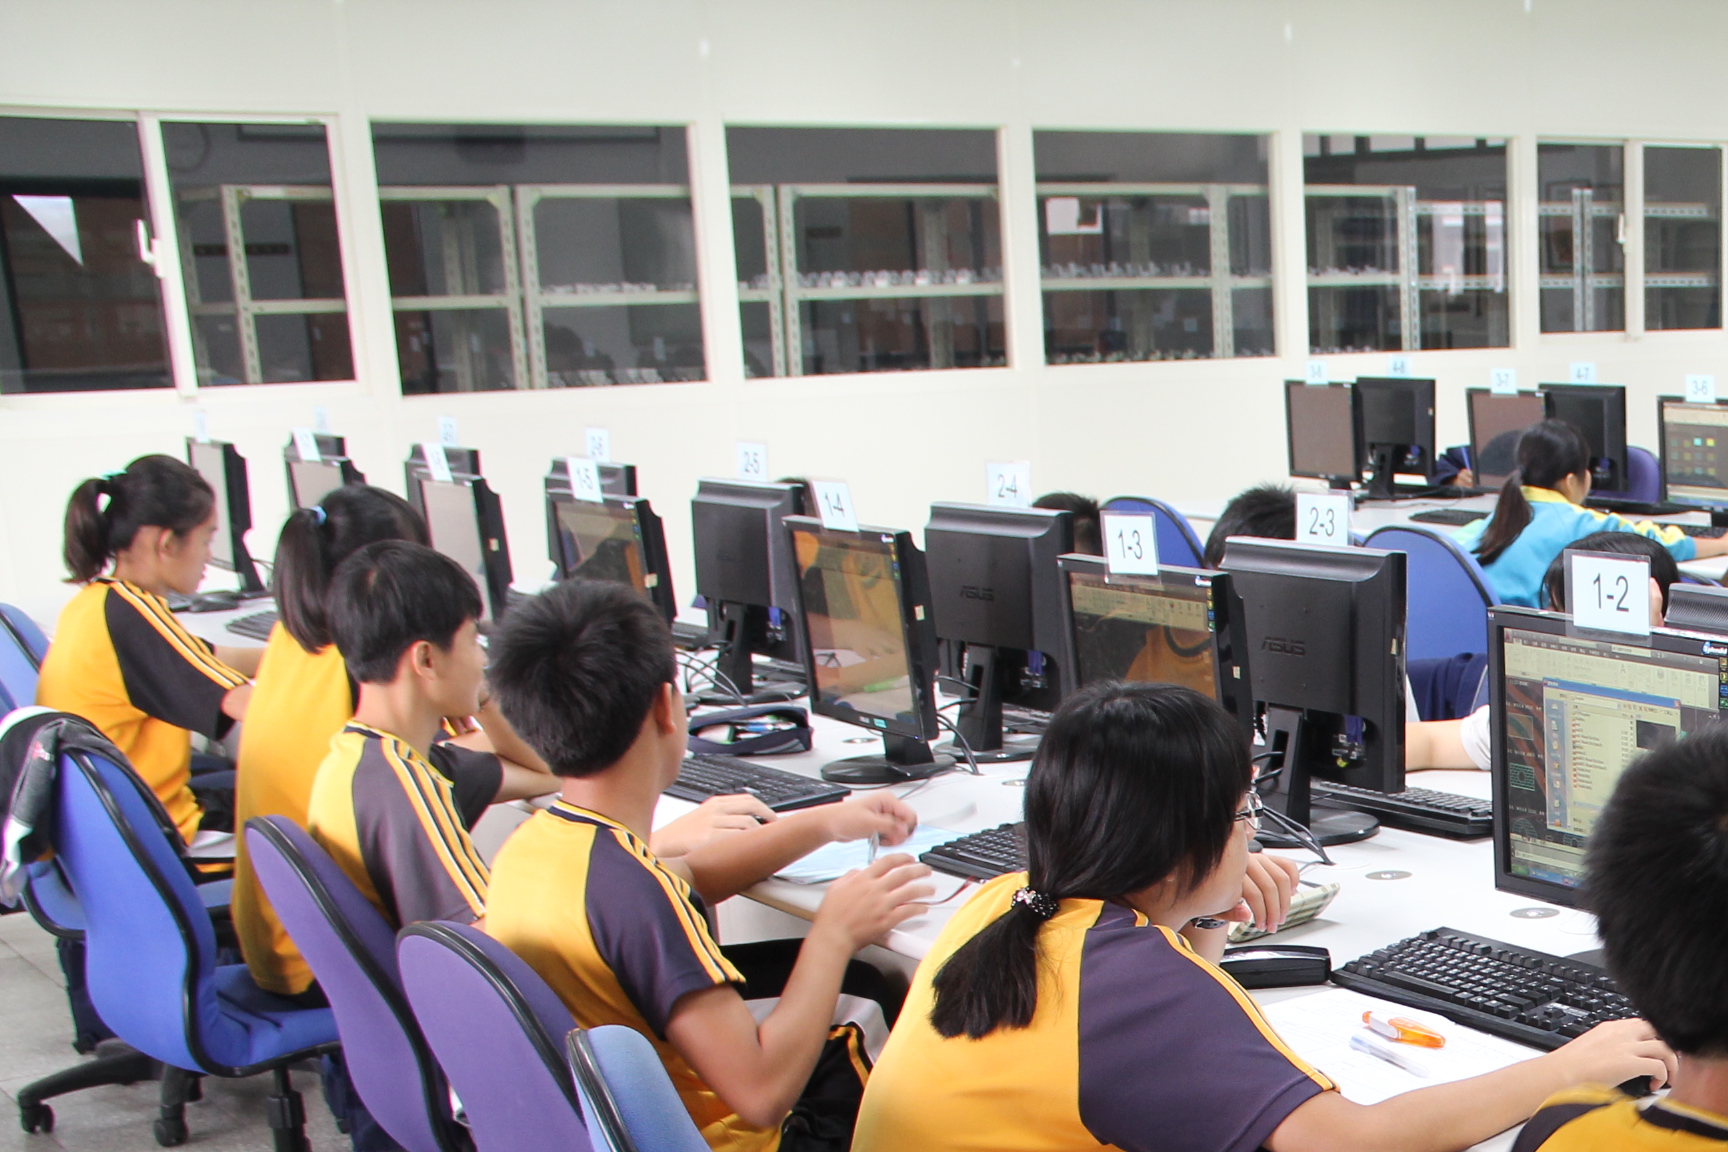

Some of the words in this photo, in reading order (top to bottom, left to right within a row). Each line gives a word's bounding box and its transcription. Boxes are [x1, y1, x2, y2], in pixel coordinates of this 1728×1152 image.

[1692, 380, 1708, 395] 3-6
[743, 450, 761, 474] 2-5
[577, 467, 594, 491] 1-5
[996, 473, 1019, 499] 2-4
[824, 492, 846, 518] 1-4
[1308, 506, 1335, 538] 2-3
[1117, 529, 1143, 560] 1-3
[960, 585, 995, 602] ASUS
[1592, 572, 1631, 614] 1-2
[1260, 635, 1306, 656] ASUS
